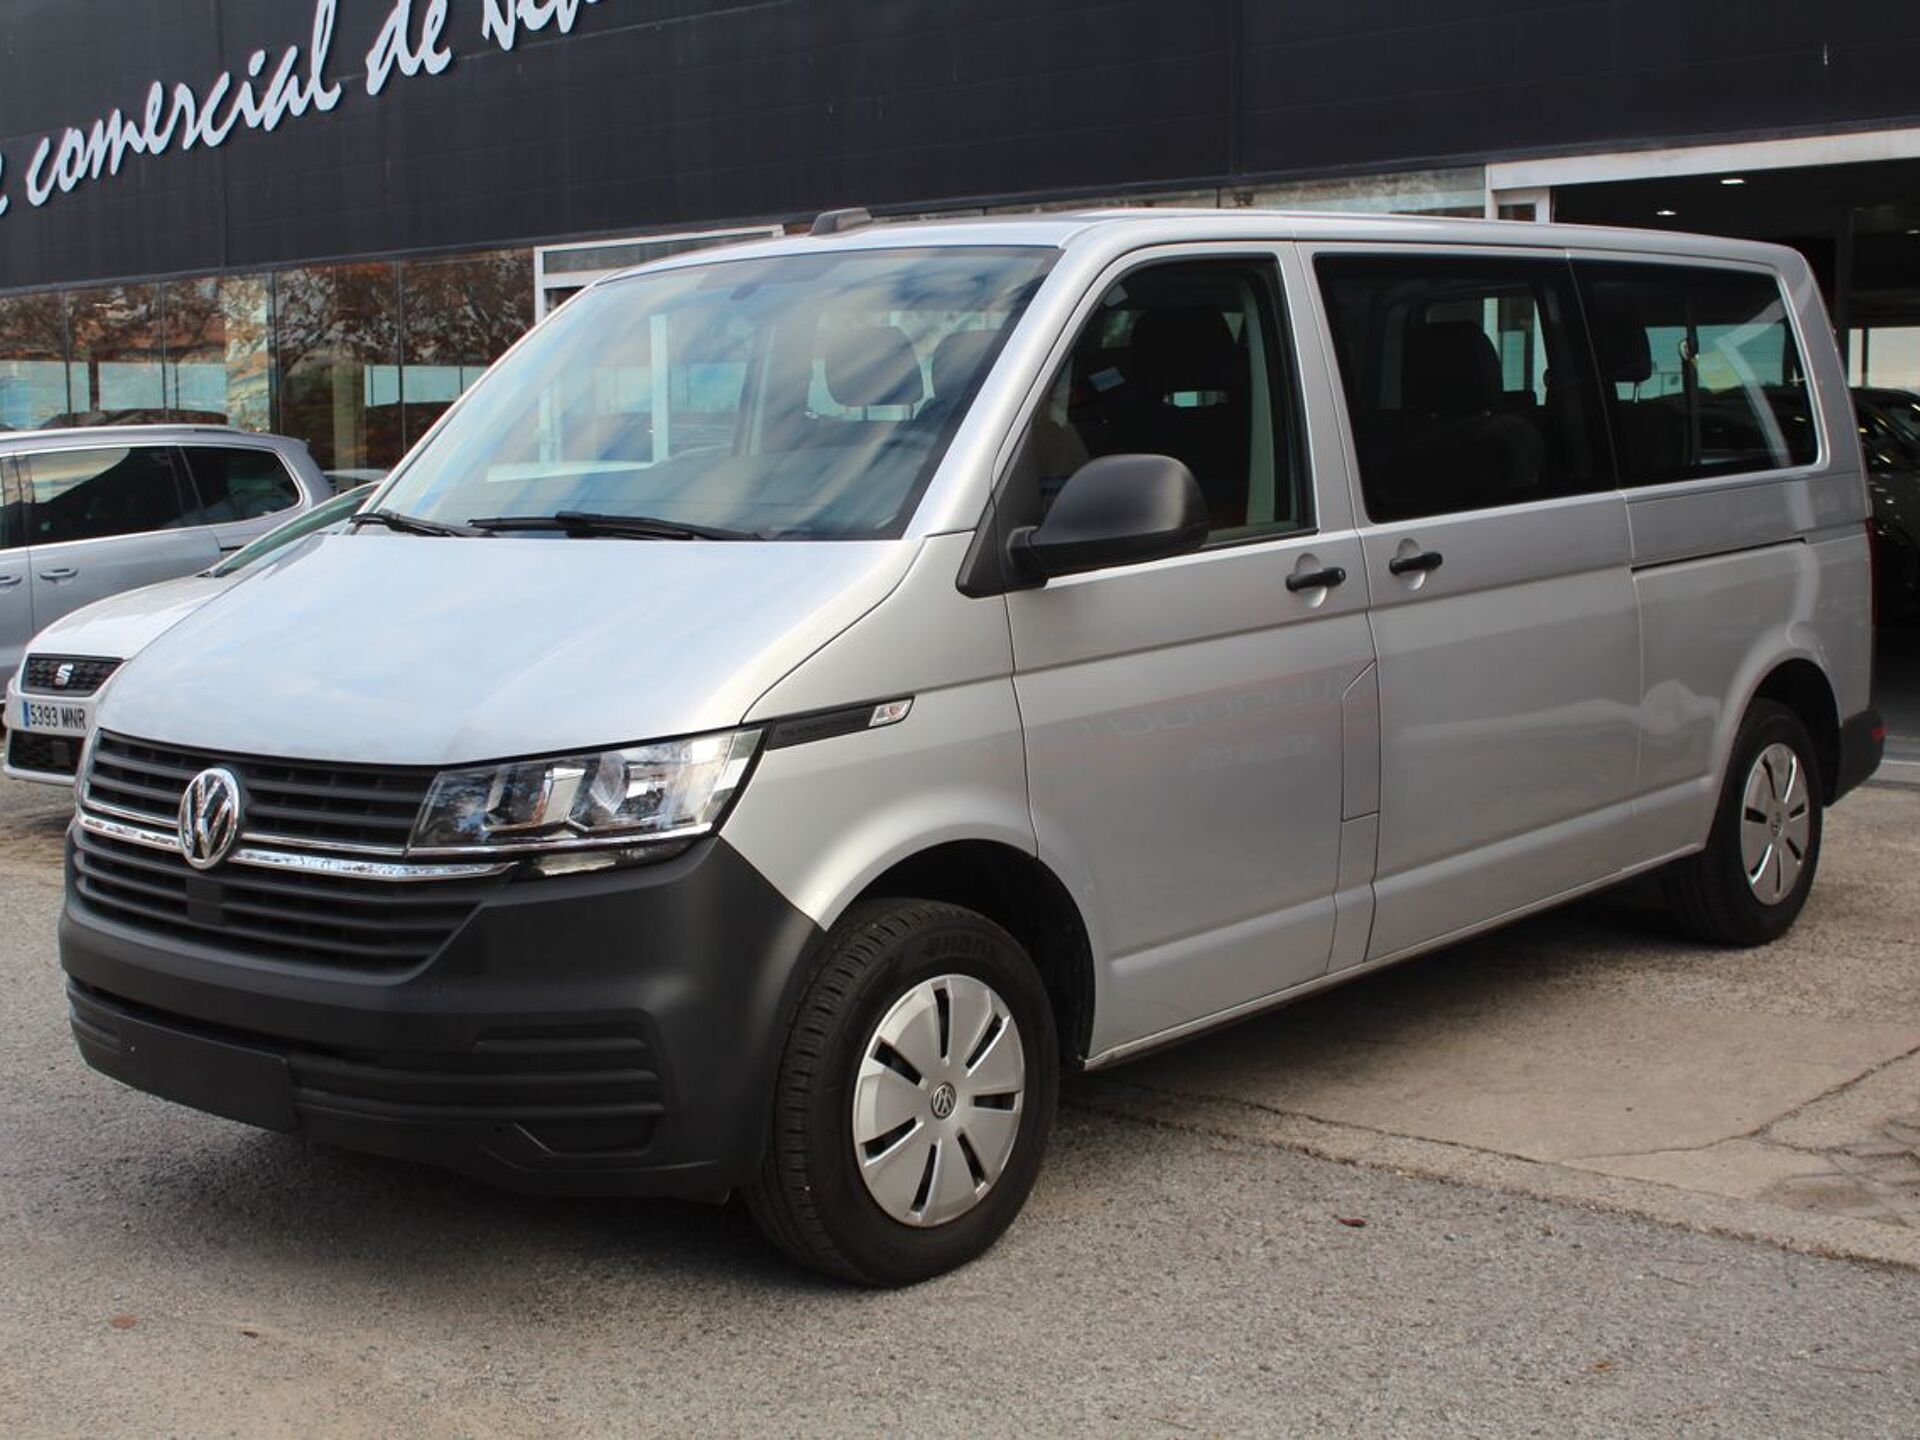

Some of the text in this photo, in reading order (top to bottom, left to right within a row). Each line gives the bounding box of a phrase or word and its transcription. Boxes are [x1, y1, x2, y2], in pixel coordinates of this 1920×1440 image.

[26, 0, 342, 207] comercial
[365, 0, 452, 96] de
[30, 704, 86, 730] 5393 MNR
